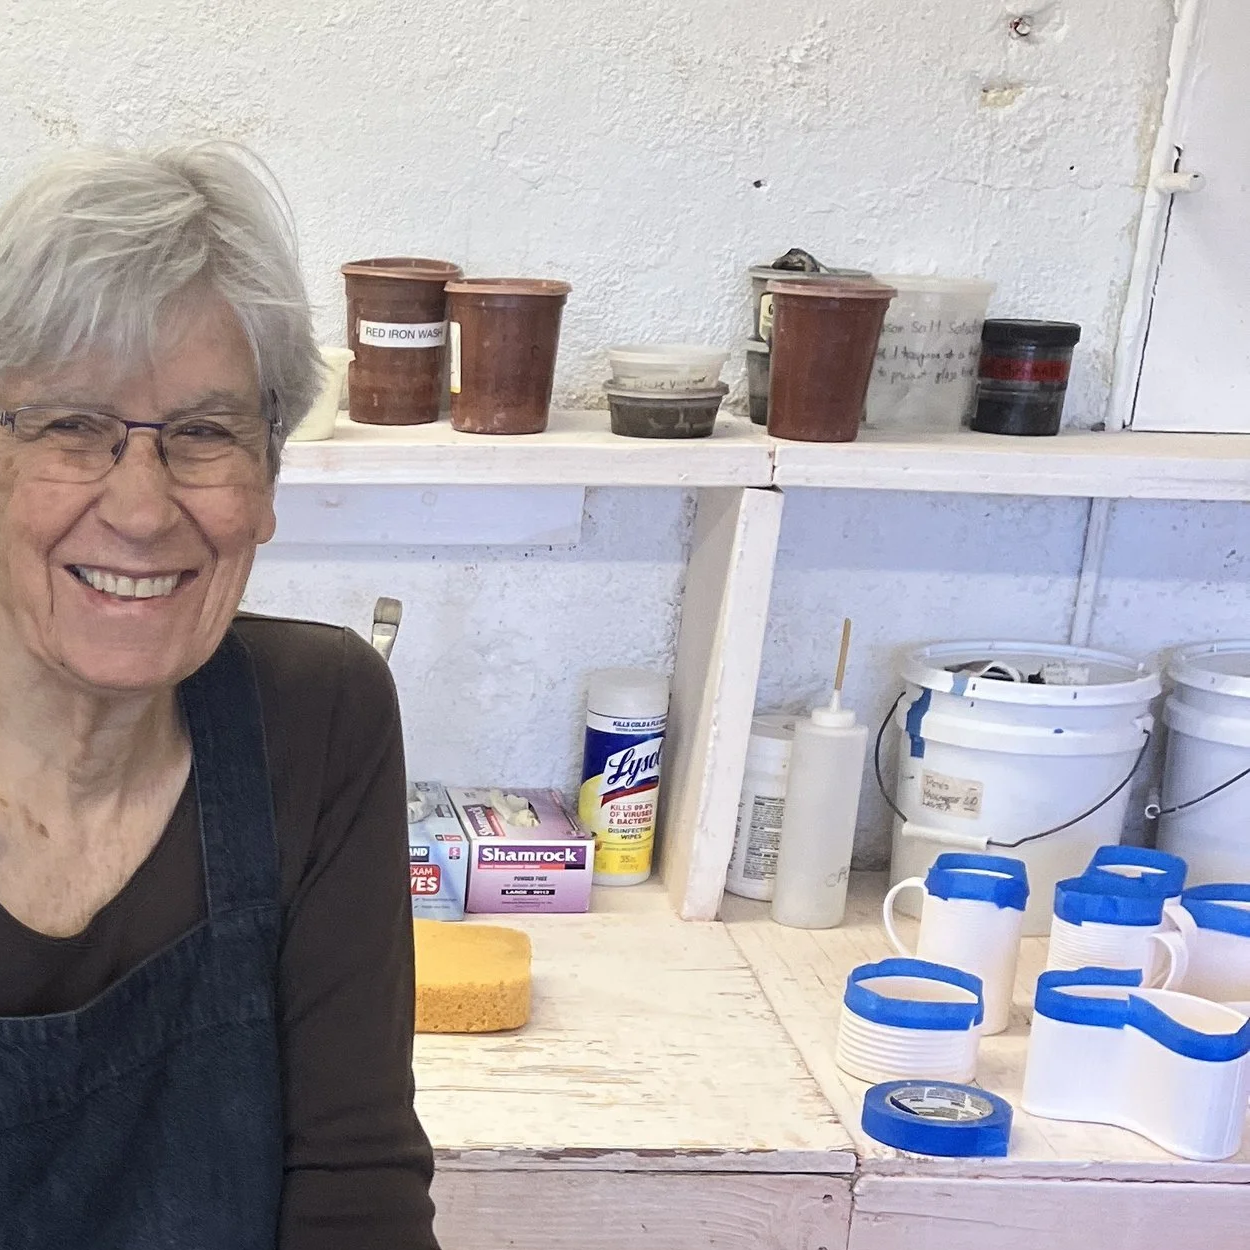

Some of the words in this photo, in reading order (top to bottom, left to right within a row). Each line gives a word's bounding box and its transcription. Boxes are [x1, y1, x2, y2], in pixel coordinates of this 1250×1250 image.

[365, 326, 386, 339] RED
[388, 329, 416, 340] IRON
[417, 328, 443, 339] WASH
[613, 720, 630, 728] KILLS
[631, 720, 648, 728] COLD
[623, 810, 653, 818] VIRUSES
[616, 817, 652, 825] BACTERIA
[482, 847, 578, 862] Shamrock
